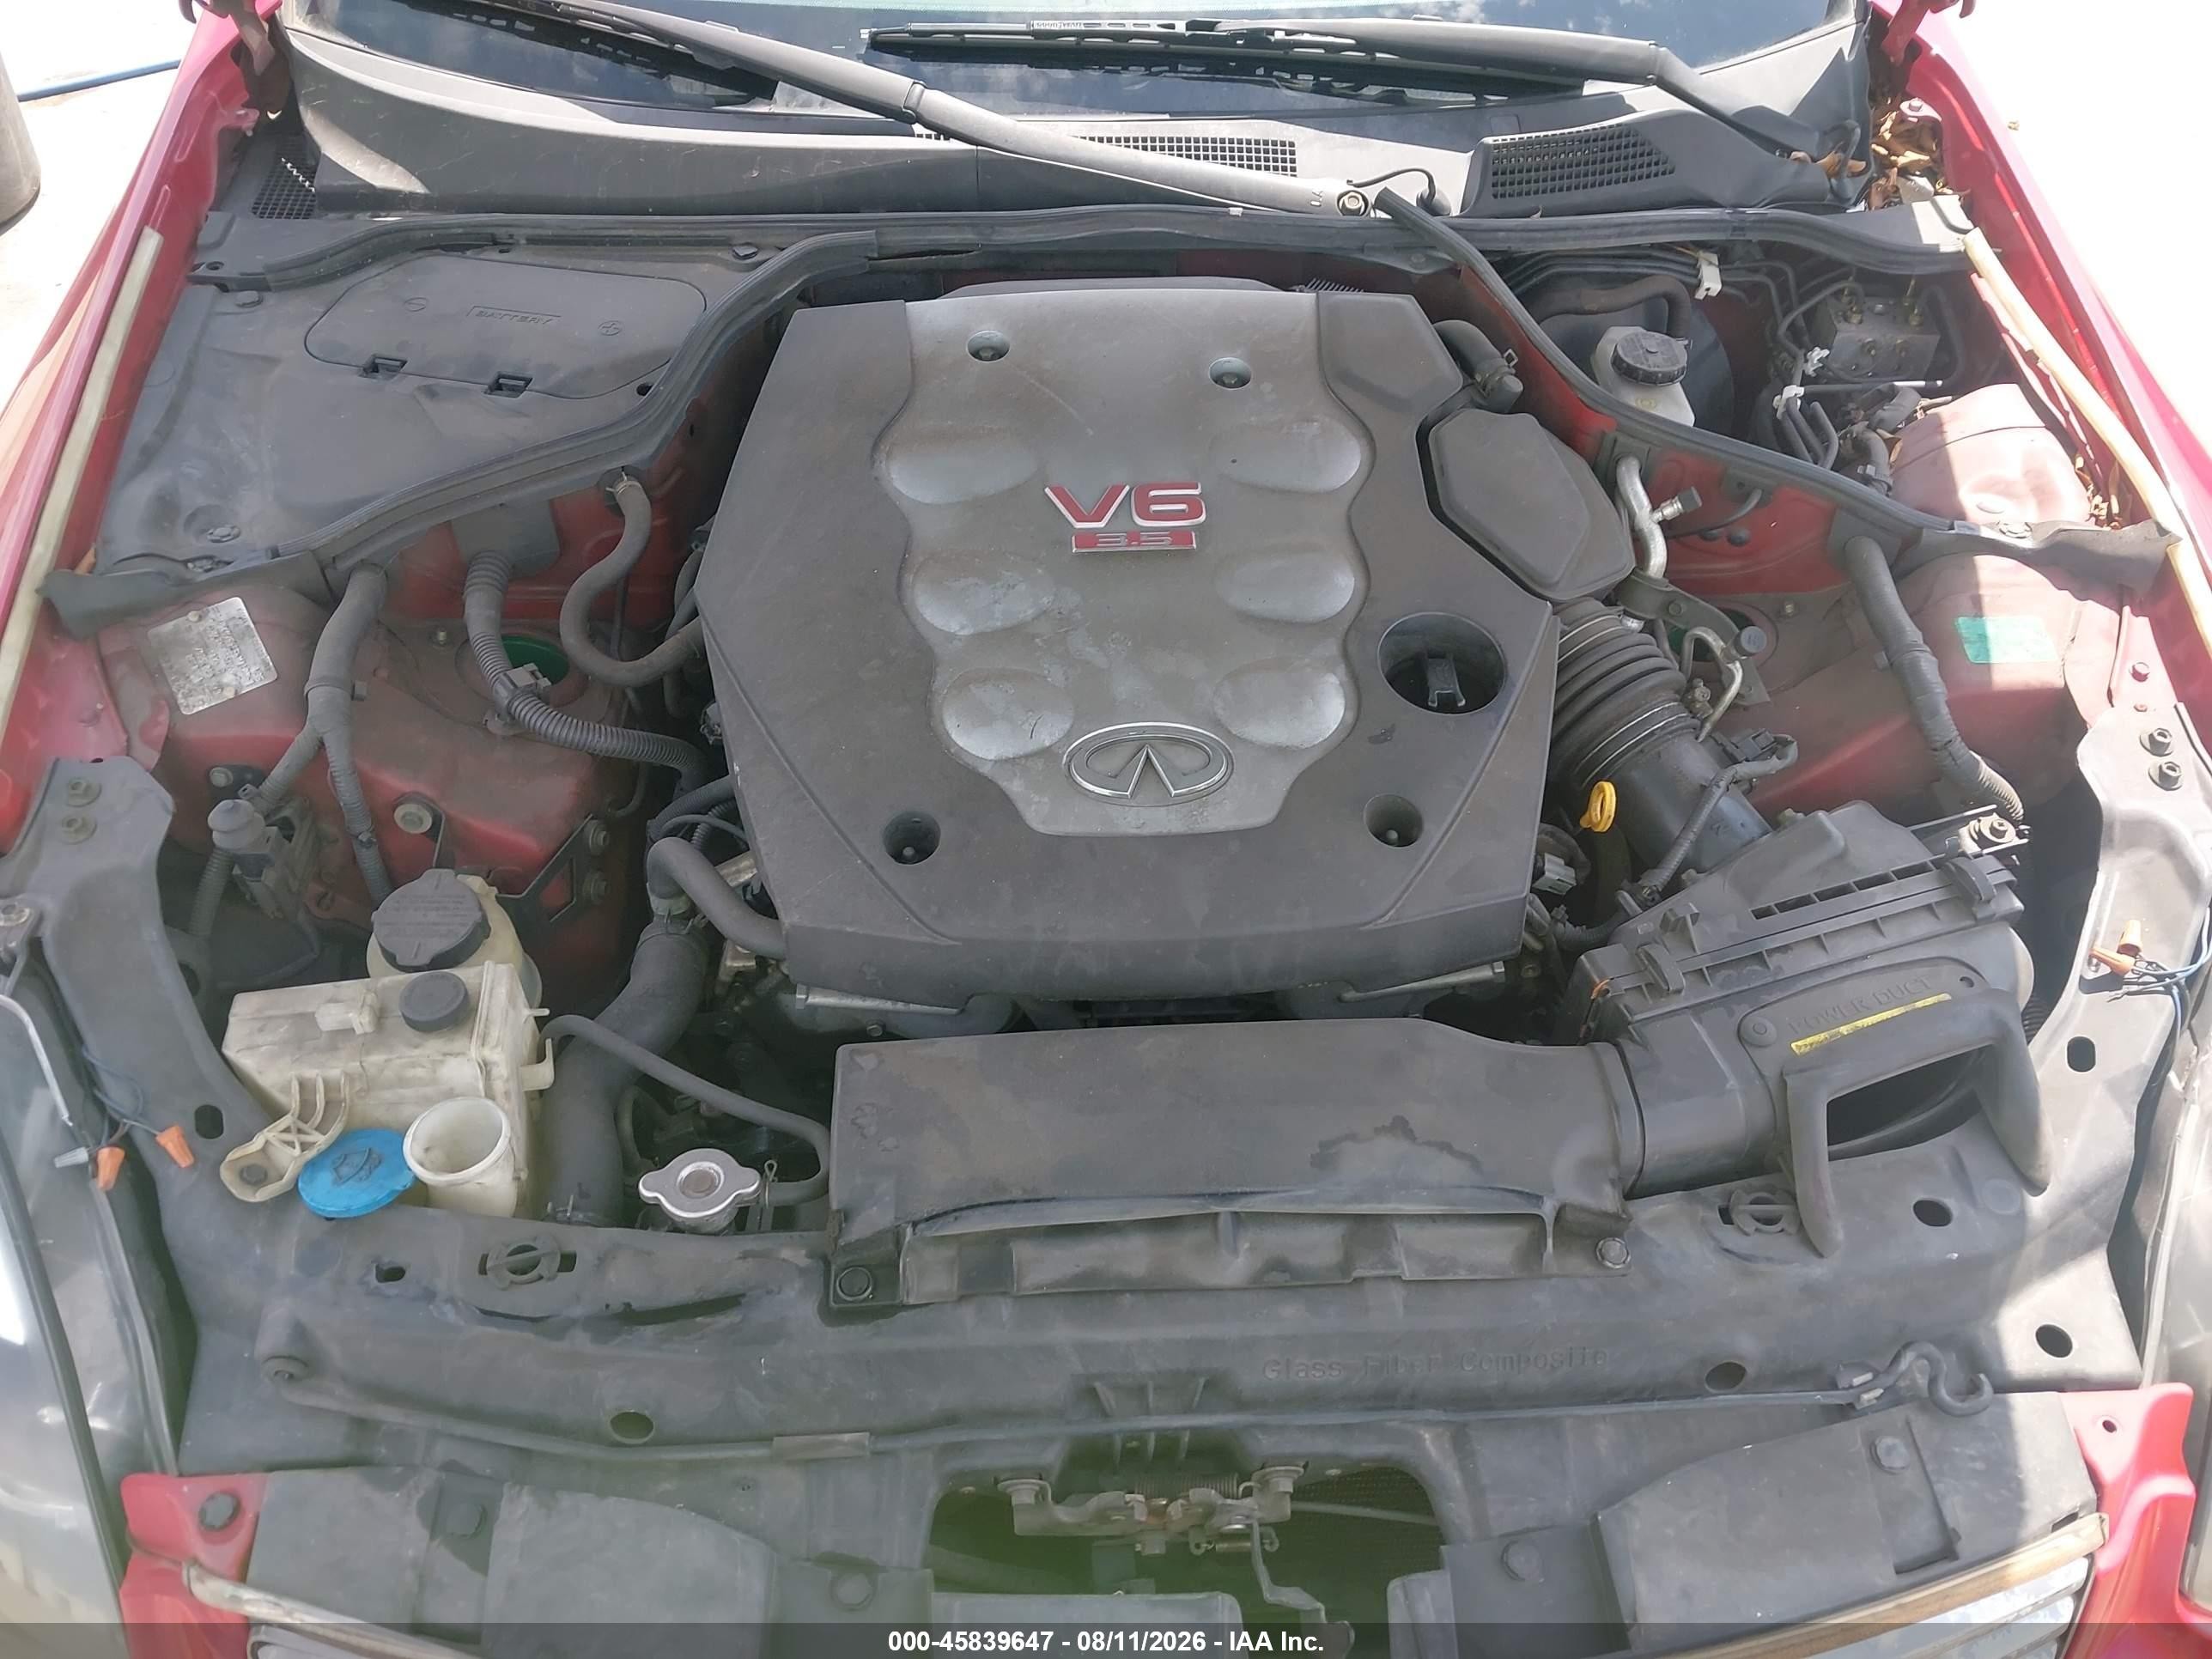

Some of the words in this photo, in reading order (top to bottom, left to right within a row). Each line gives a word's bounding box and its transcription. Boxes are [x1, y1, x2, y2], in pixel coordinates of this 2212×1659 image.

[475, 310, 554, 325] BATTERY
[1044, 482, 1206, 529] V6
[1096, 532, 1173, 547] 3.5
[1787, 997, 1871, 1036] POWER
[1872, 975, 1932, 1006] DUCT
[1262, 1357, 1345, 1381] Glass
[1362, 1352, 1443, 1376] Fiber
[1459, 1346, 1609, 1376] Composite
